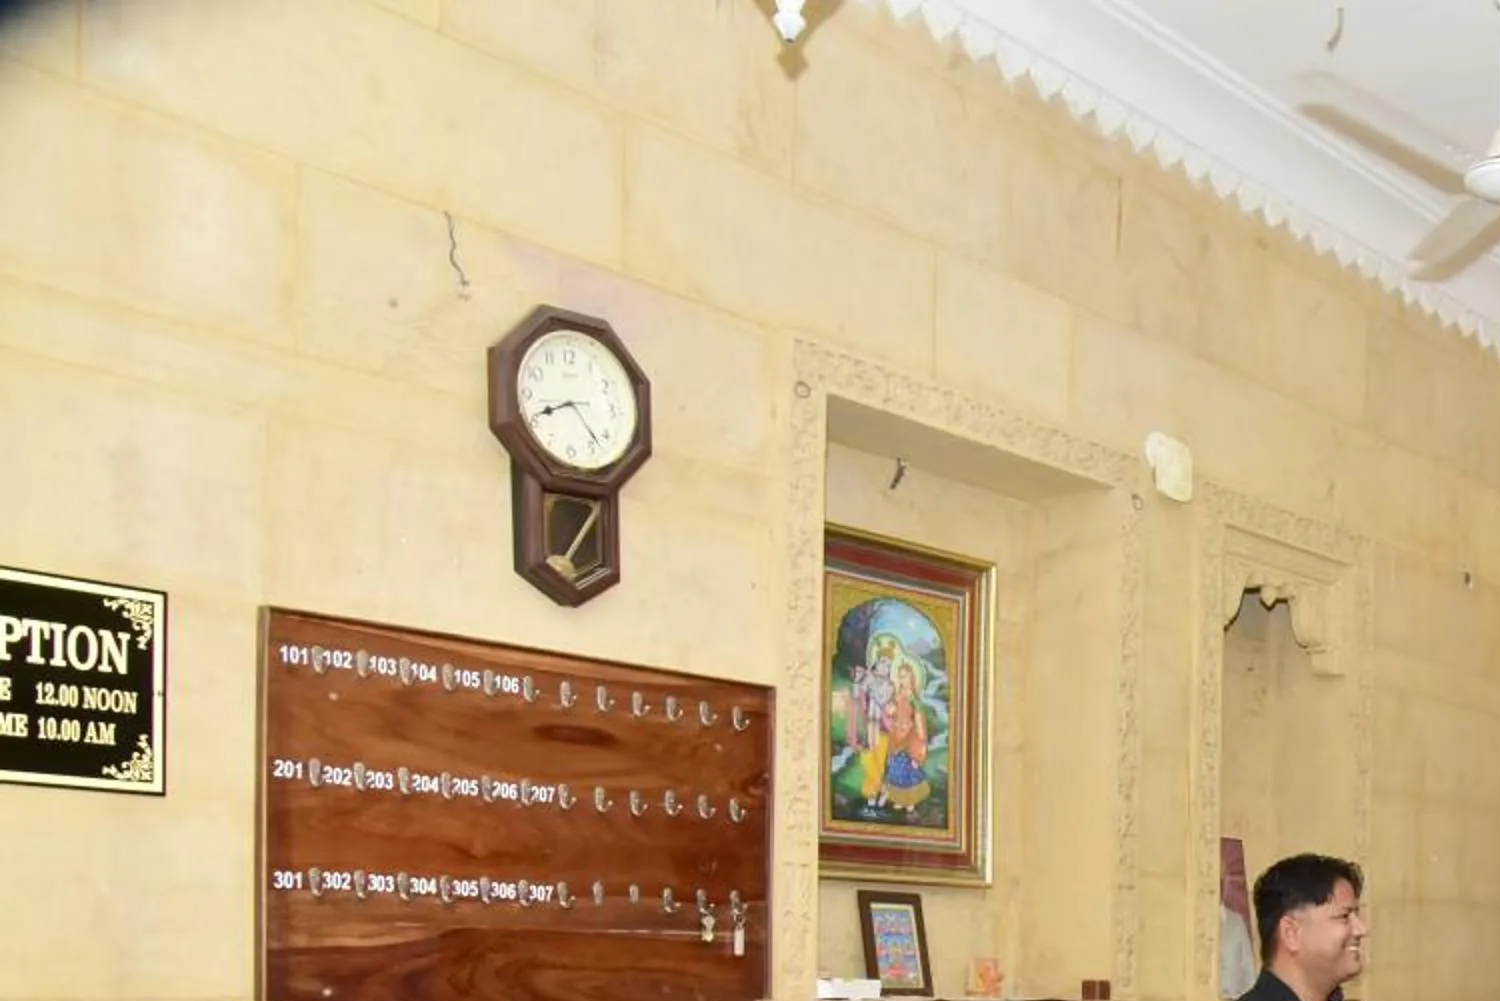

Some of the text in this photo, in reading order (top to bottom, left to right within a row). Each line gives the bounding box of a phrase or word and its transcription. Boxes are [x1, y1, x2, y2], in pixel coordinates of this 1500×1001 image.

[562, 349, 575, 365] 12
[601, 378, 609, 395] 2
[280, 645, 519, 693] 101 102 103 104 105 106
[35, 681, 79, 708] 12.00
[82, 685, 138, 714] NOON
[38, 716, 81, 742] 10.00
[84, 721, 116, 746] AM
[273, 760, 554, 802] 201 202 203 204 205 206 207
[273, 872, 553, 901] 301 302 303 304 305 306 307
